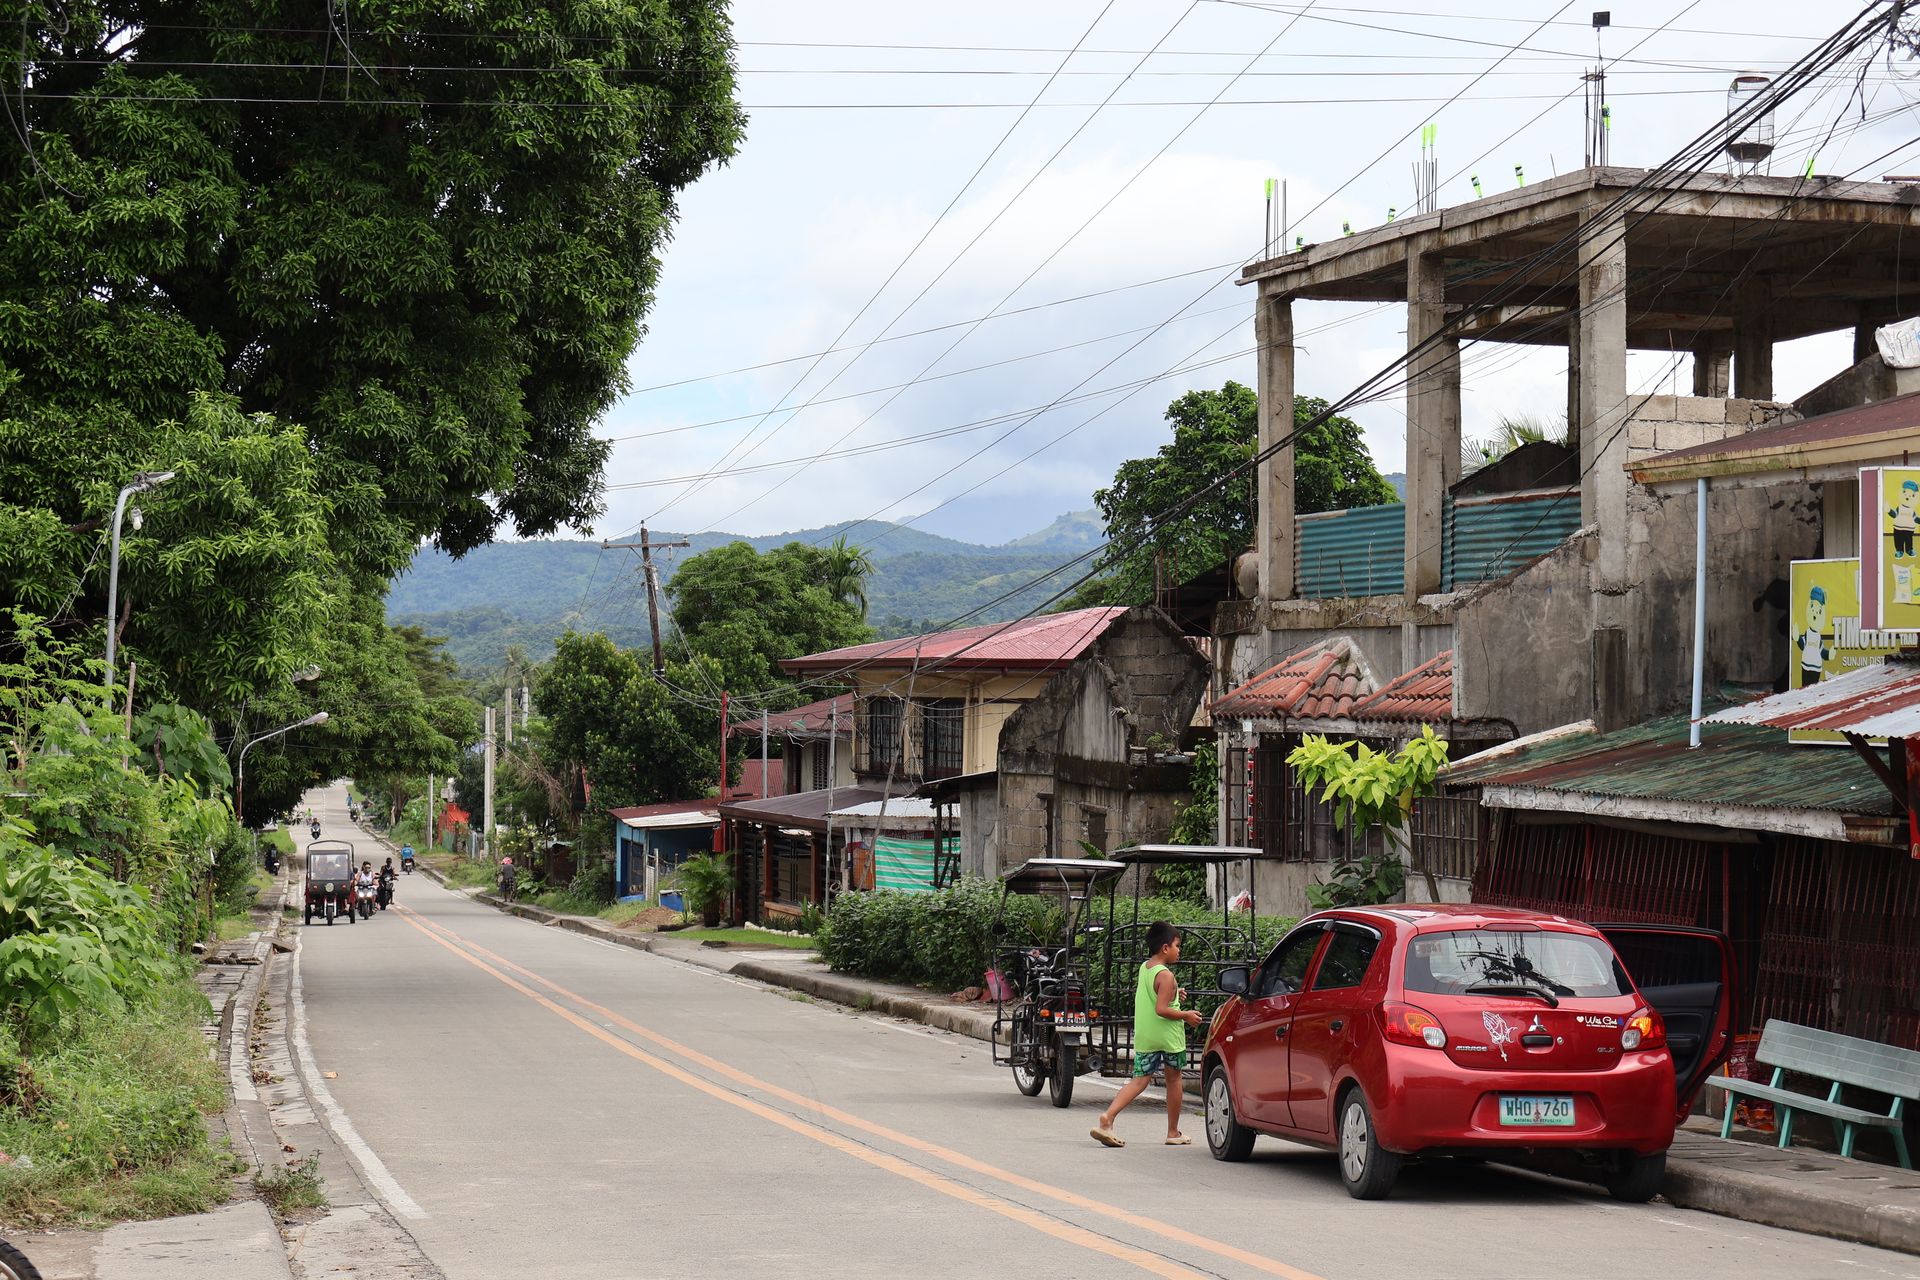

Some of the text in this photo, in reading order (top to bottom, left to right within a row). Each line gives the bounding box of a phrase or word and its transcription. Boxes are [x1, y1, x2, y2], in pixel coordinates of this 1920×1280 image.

[1842, 656, 1868, 667] SUNJIN
[1506, 1100, 1569, 1116] WHO 760
